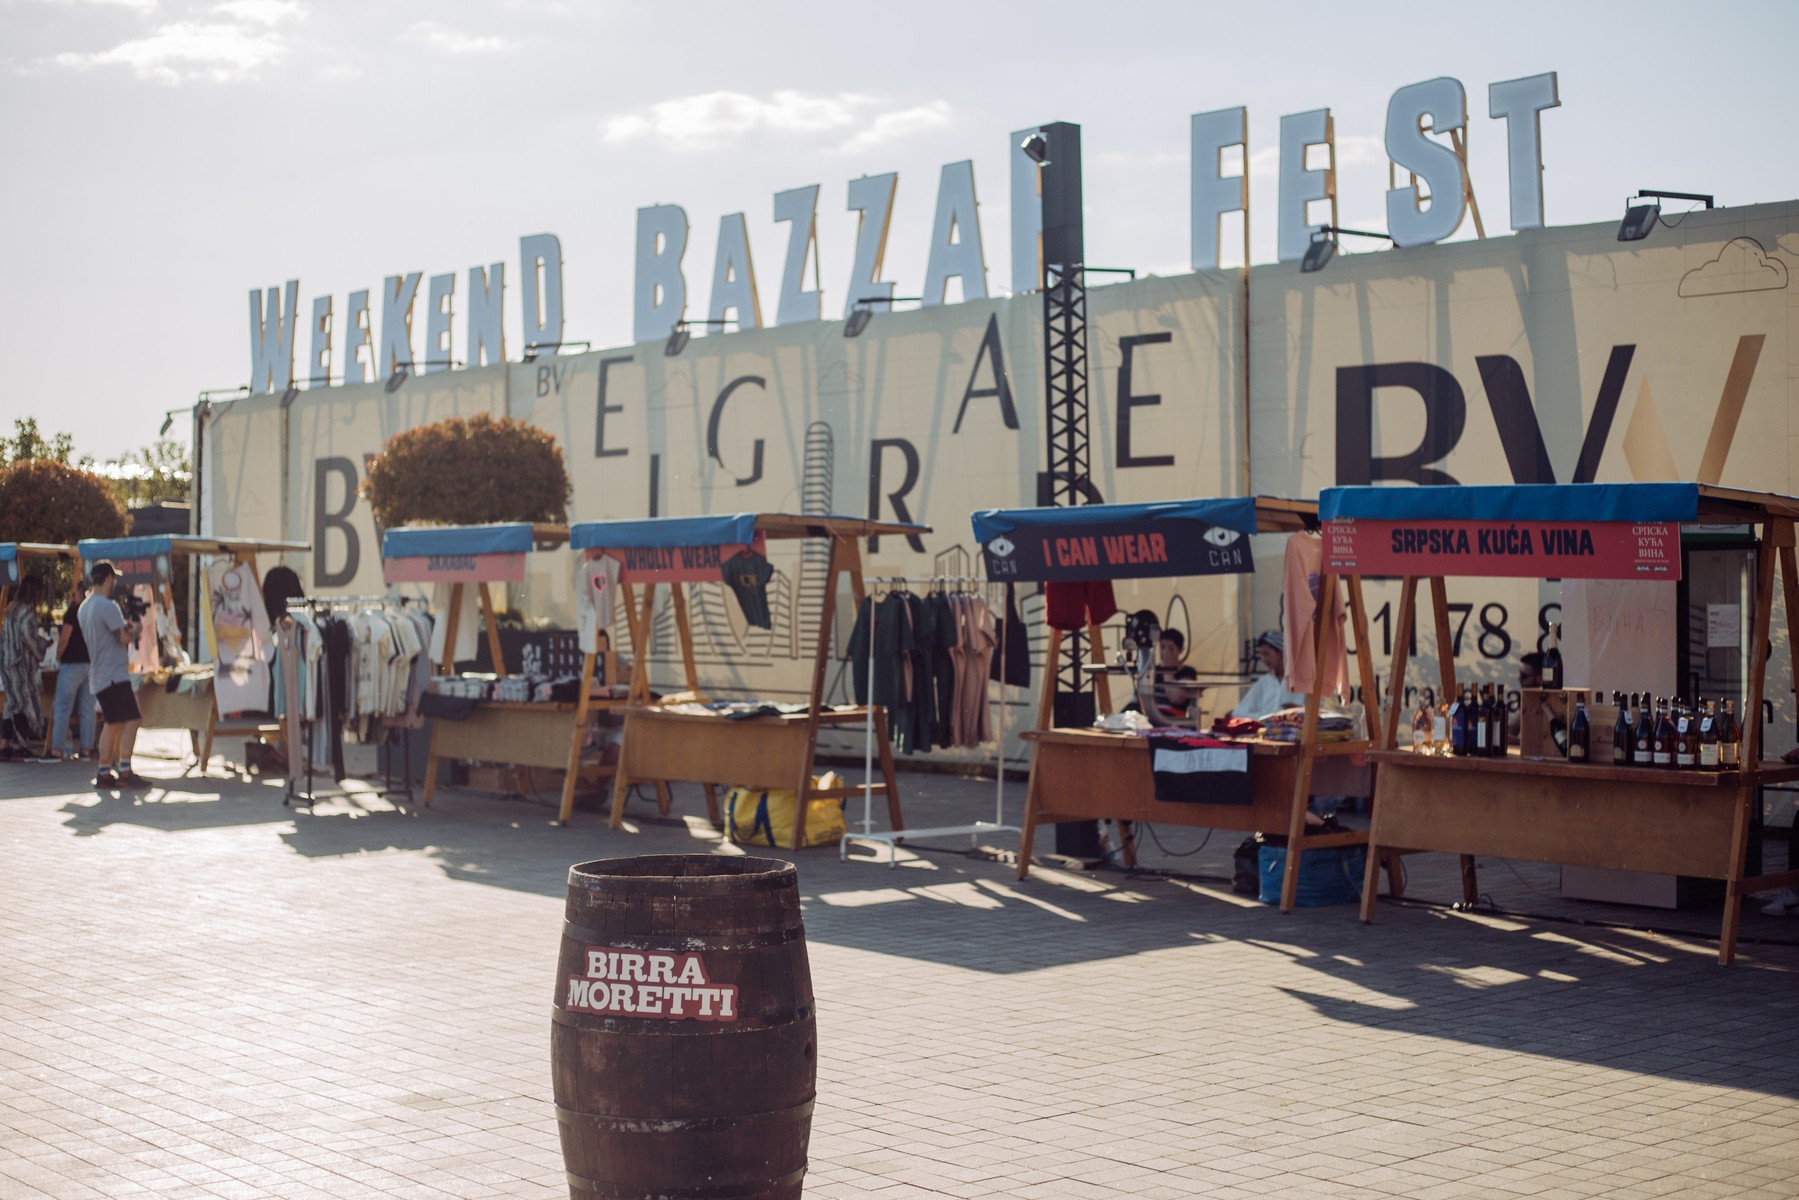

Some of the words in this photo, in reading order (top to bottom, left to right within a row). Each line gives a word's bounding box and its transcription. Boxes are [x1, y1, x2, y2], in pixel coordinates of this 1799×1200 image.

[249, 233, 564, 395] WEEKEND
[1191, 71, 1561, 270] FEST
[1391, 528, 1471, 554] SRPSKA
[1478, 524, 1534, 555] KUĆA
[1541, 529, 1595, 556] VINA
[1632, 526, 1668, 536] СРПСКА
[625, 547, 674, 571] WHOLLY
[681, 545, 721, 569] WEAR
[1042, 538, 1053, 567] I
[1055, 537, 1099, 567] CAN
[1102, 533, 1169, 566] WEAR
[1209, 549, 1243, 567] CAN
[1638, 548, 1664, 558] ВИНА
[992, 559, 1017, 575] CAN
[587, 950, 705, 985] BIRRA
[567, 979, 734, 1017] MORETTI
